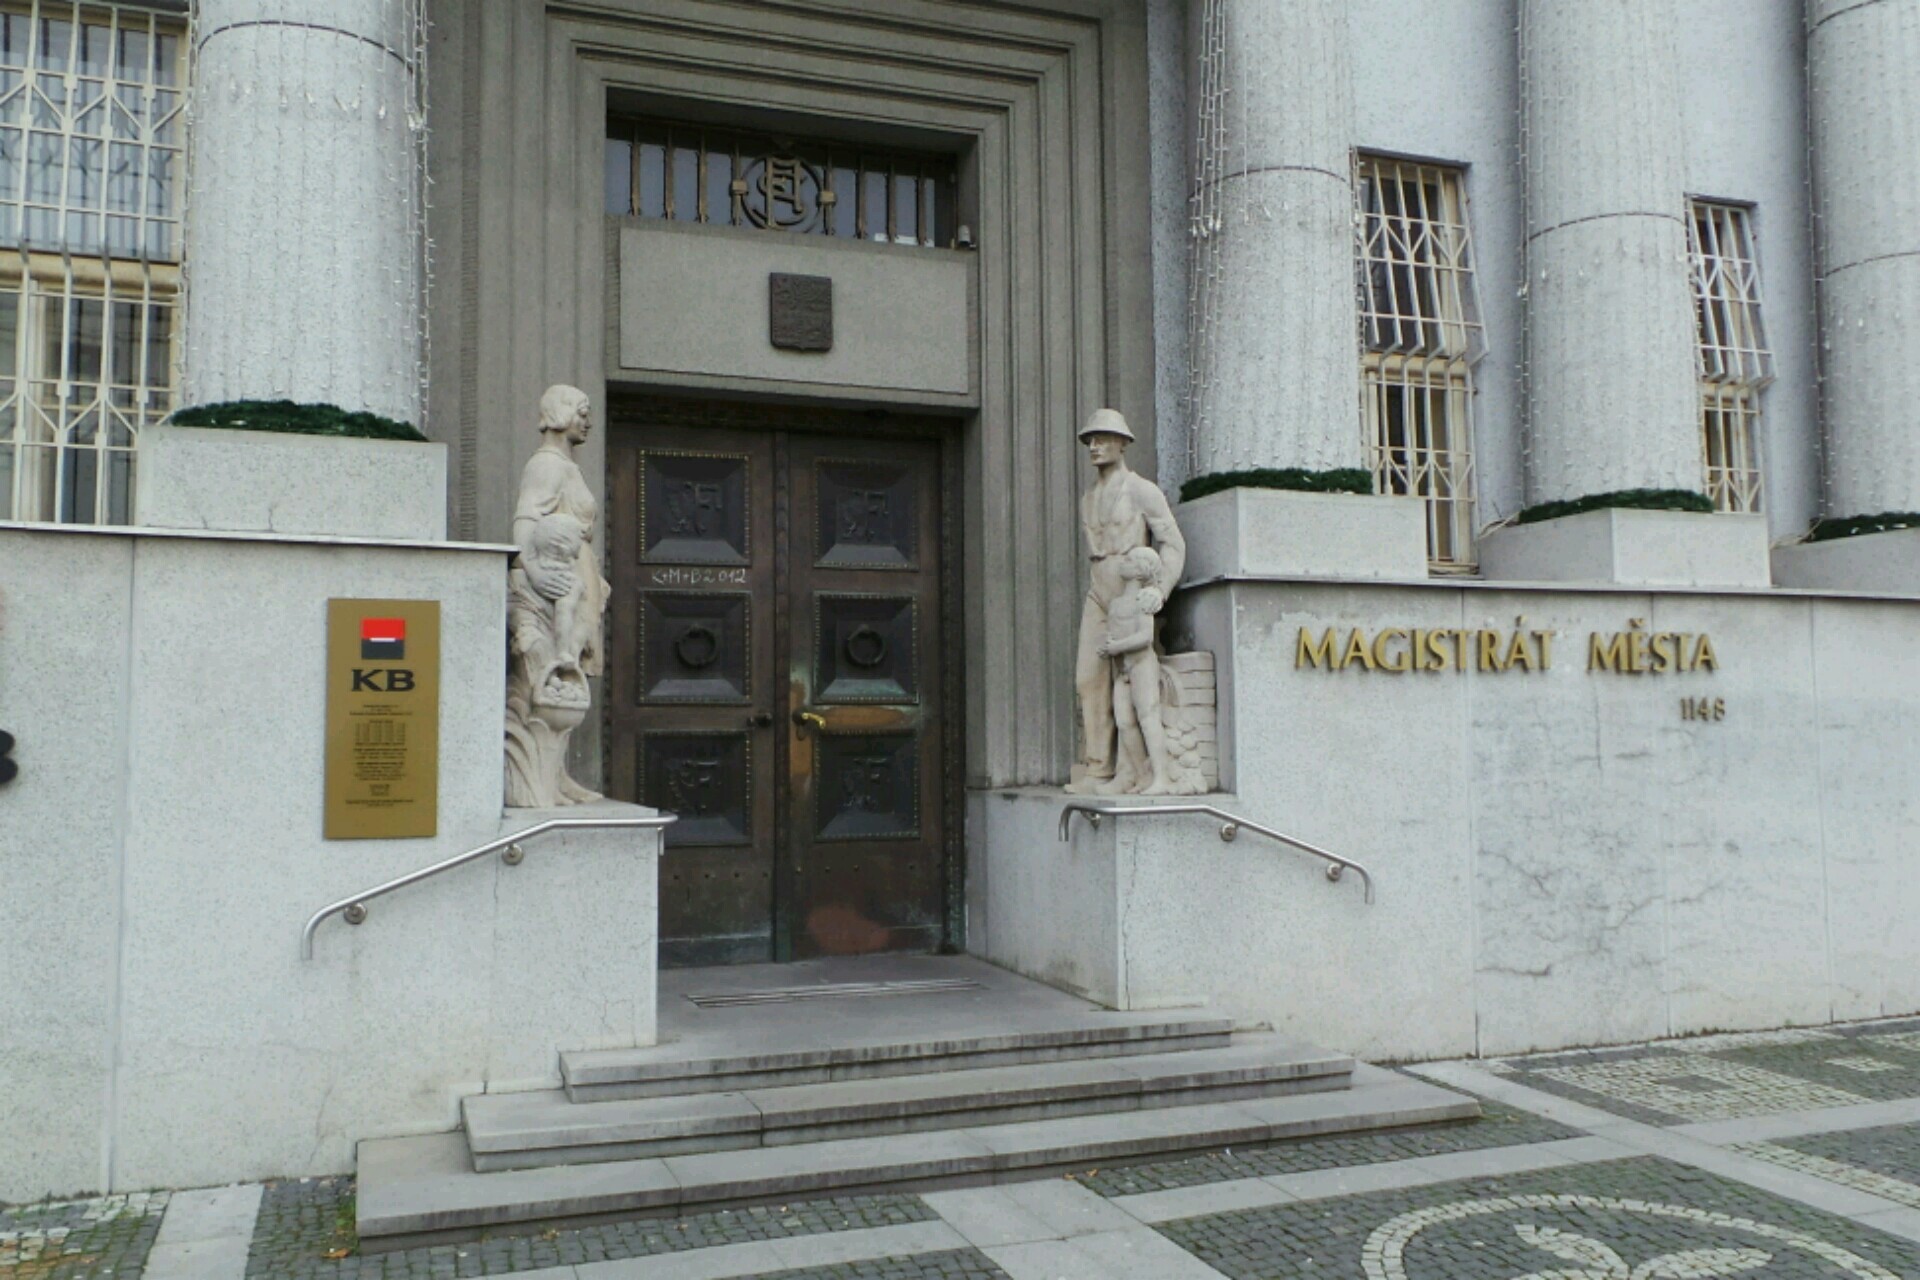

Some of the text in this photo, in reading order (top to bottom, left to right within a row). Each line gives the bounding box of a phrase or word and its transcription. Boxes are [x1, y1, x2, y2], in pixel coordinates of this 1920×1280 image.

[1295, 615, 1719, 674] MAGISTRÁT MĚSTA
[351, 669, 416, 692] KB
[1680, 697, 1725, 721] 1148
